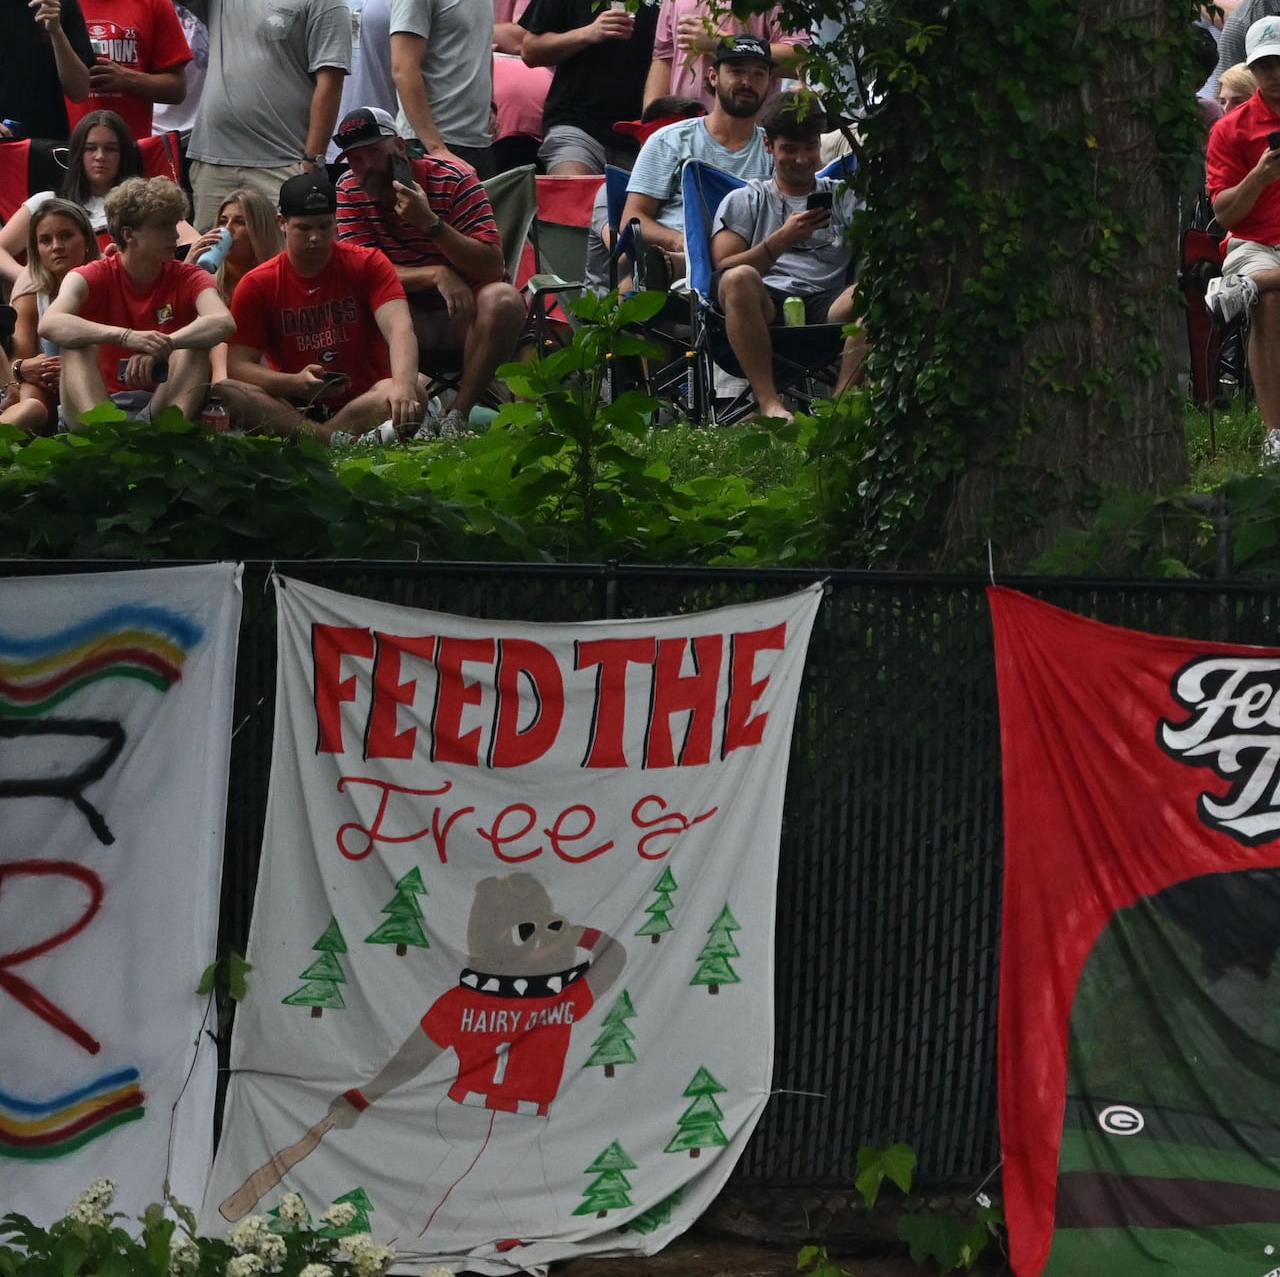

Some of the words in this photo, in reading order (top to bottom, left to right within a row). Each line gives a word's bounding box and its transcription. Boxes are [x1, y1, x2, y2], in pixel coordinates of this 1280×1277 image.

[296, 326, 350, 352] BASEBALL
[311, 622, 564, 768] FEED
[573, 622, 787, 770] THE
[336, 777, 719, 863] Trees
[460, 1007, 523, 1033] HAIRY
[524, 1001, 576, 1031] DAWG
[493, 1041, 512, 1085] 1
[1102, 1108, 1142, 1133] G
